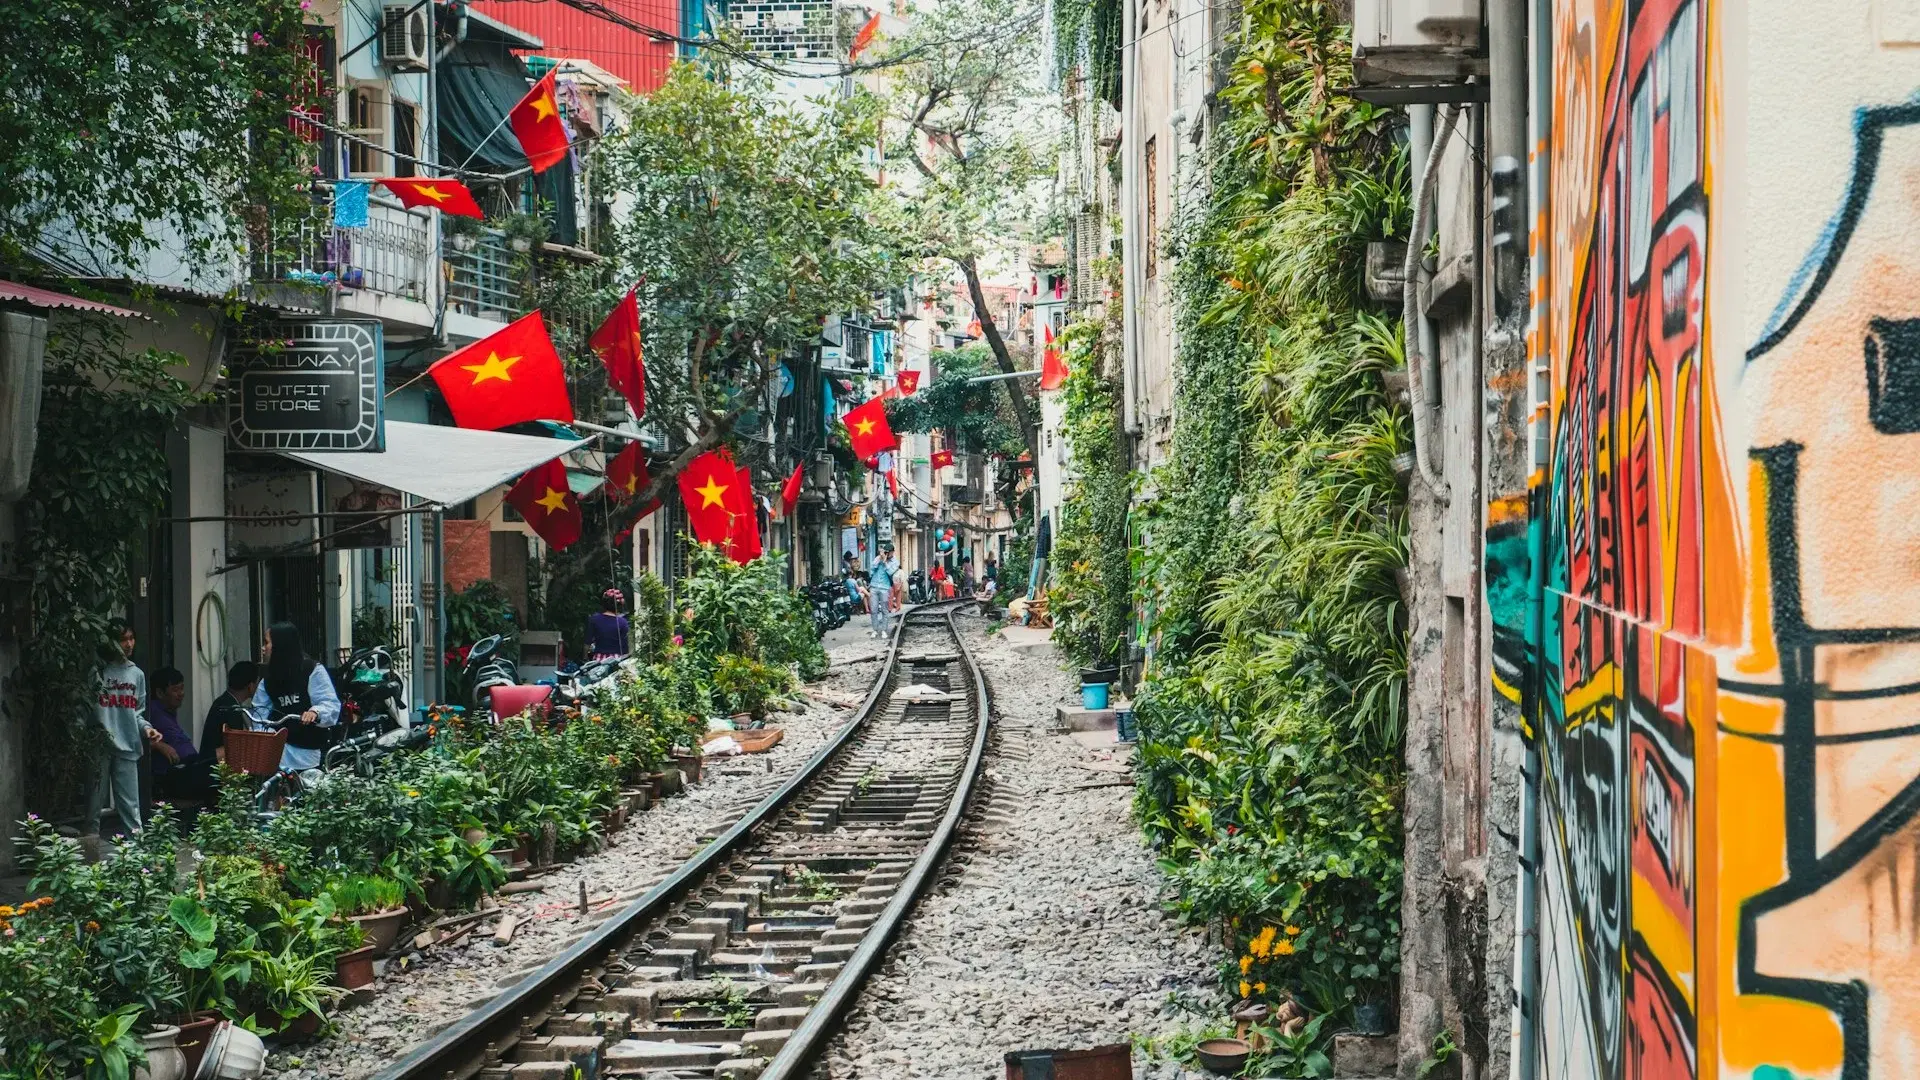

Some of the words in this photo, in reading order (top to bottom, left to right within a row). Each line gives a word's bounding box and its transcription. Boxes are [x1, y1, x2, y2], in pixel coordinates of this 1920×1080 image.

[231, 354, 357, 368] RAILWAY
[255, 385, 330, 396] OUTFIT
[255, 400, 321, 411] STORE
